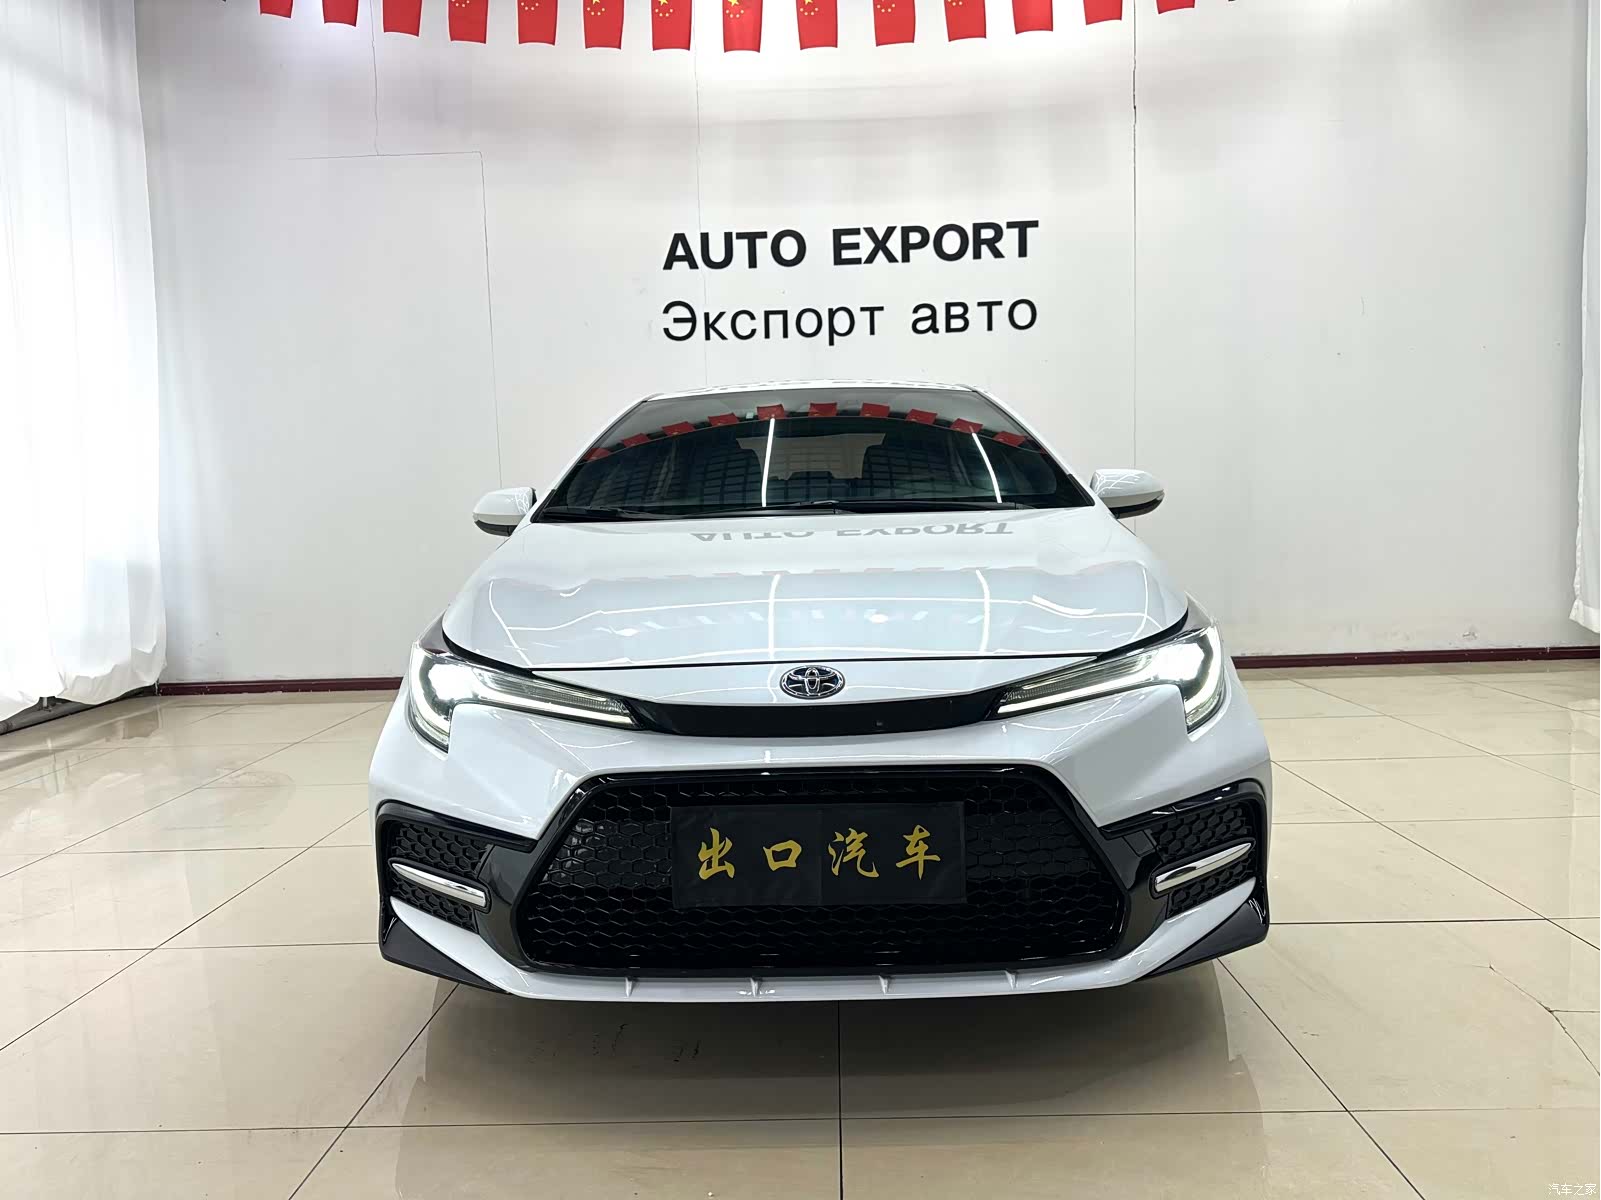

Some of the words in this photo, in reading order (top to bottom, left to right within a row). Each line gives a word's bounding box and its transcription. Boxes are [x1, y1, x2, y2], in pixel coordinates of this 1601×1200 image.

[663, 229, 807, 270] AUTO
[832, 220, 1039, 266] EXPORT
[662, 300, 885, 346] Экспорт
[911, 299, 1038, 334] авто
[698, 825, 940, 880] 出口汽车
